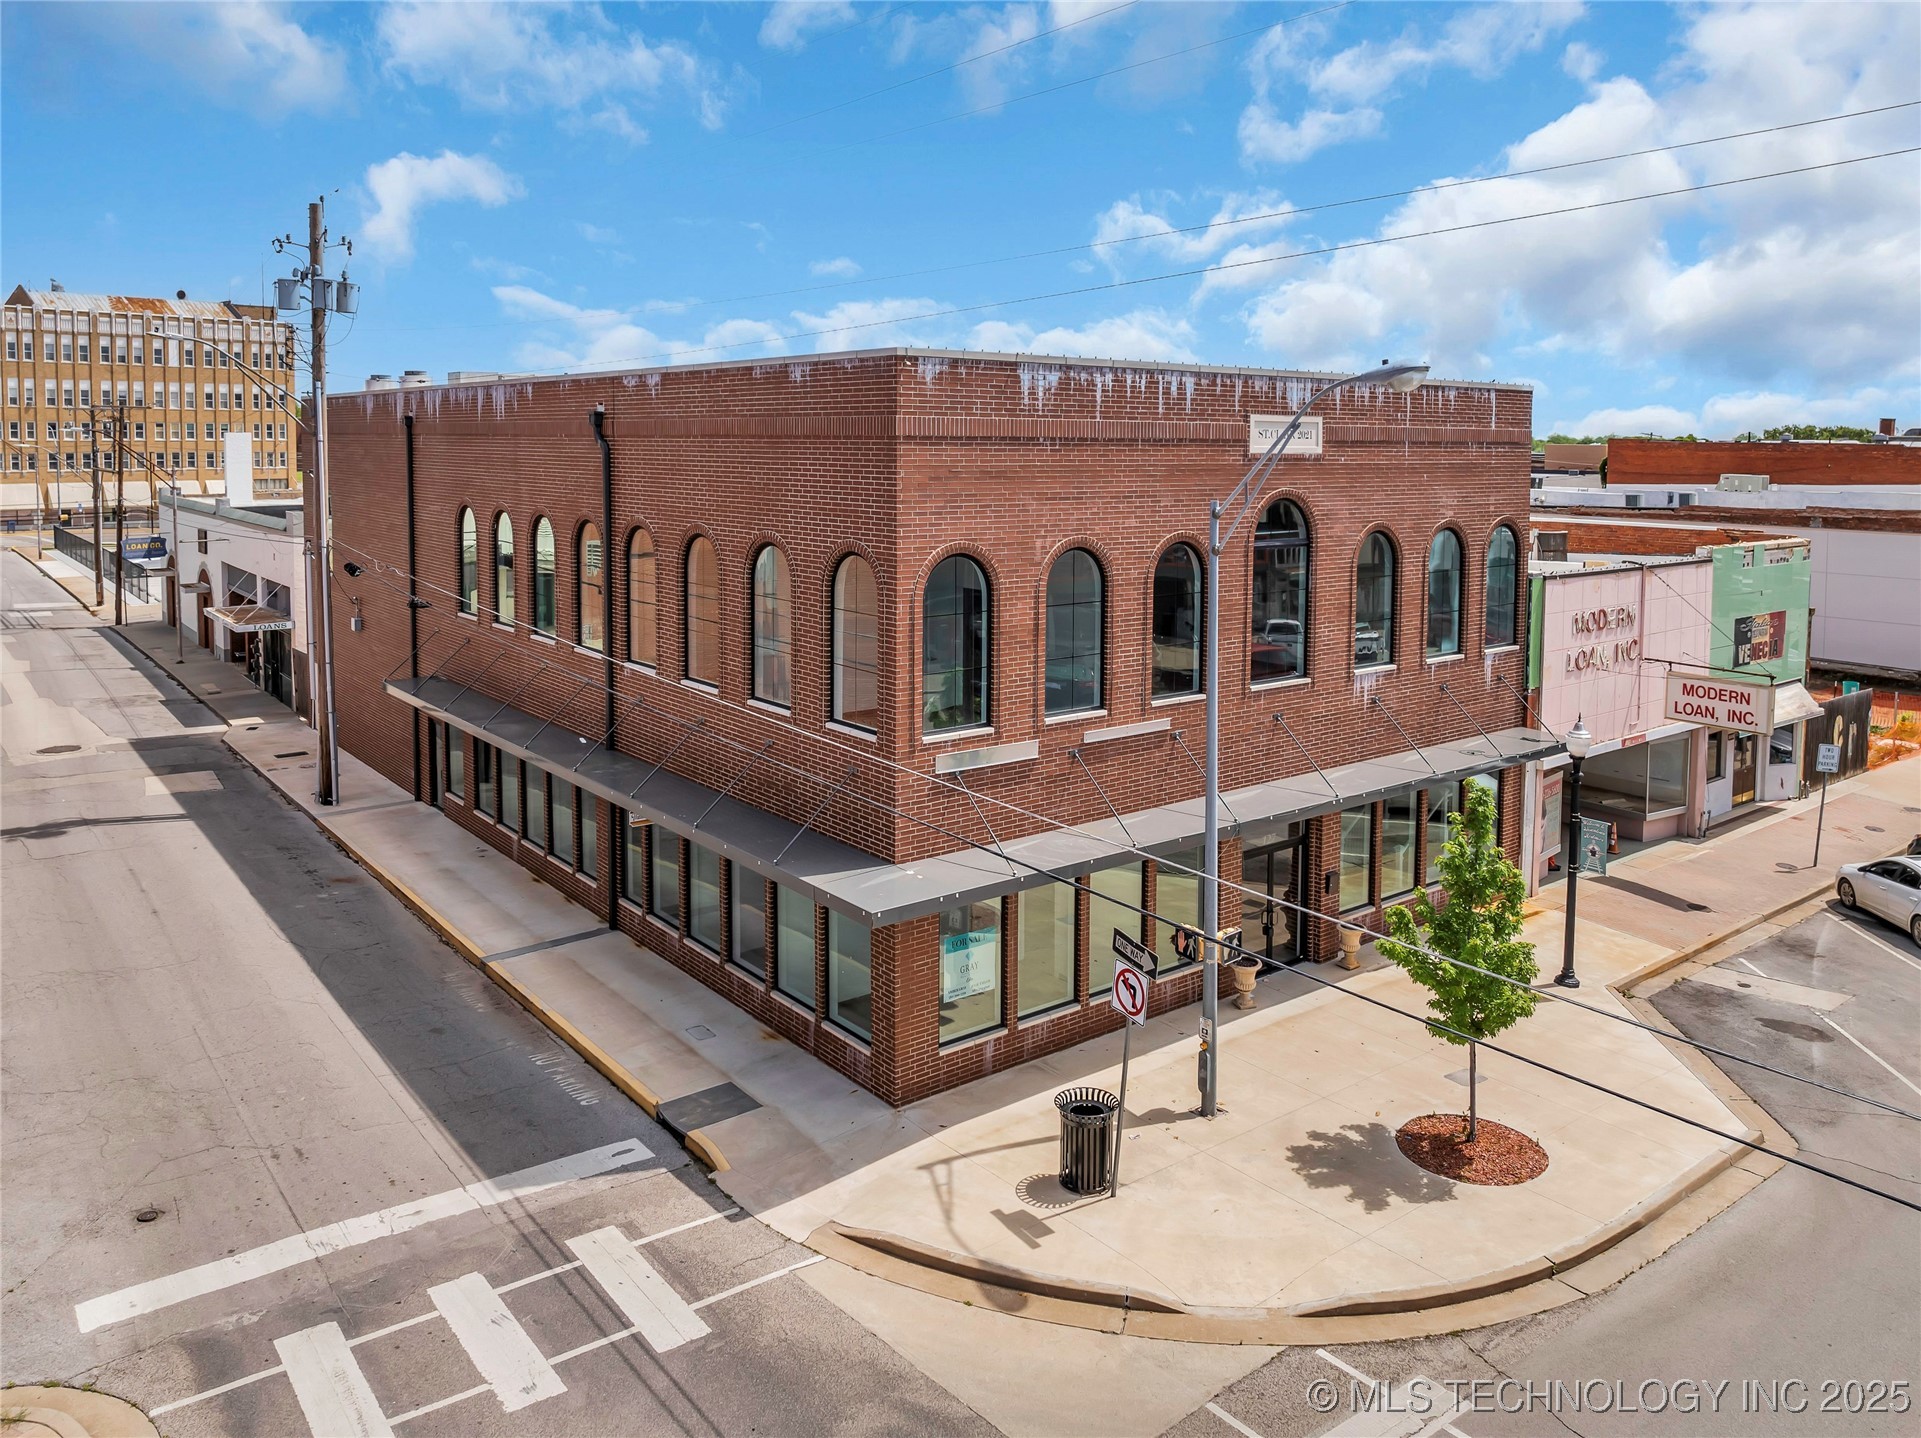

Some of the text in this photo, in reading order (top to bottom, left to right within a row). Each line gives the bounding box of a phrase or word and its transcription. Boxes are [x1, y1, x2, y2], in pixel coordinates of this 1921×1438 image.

[253, 622, 287, 631] LOANS
[1572, 604, 1636, 635] MODERN
[1682, 683, 1751, 706] MODERN
[1674, 701, 1768, 727] LOAN, INC.
[951, 934, 988, 949] FOR SALE
[1117, 938, 1143, 962] ONE WAY
[959, 961, 979, 973] GRAY
